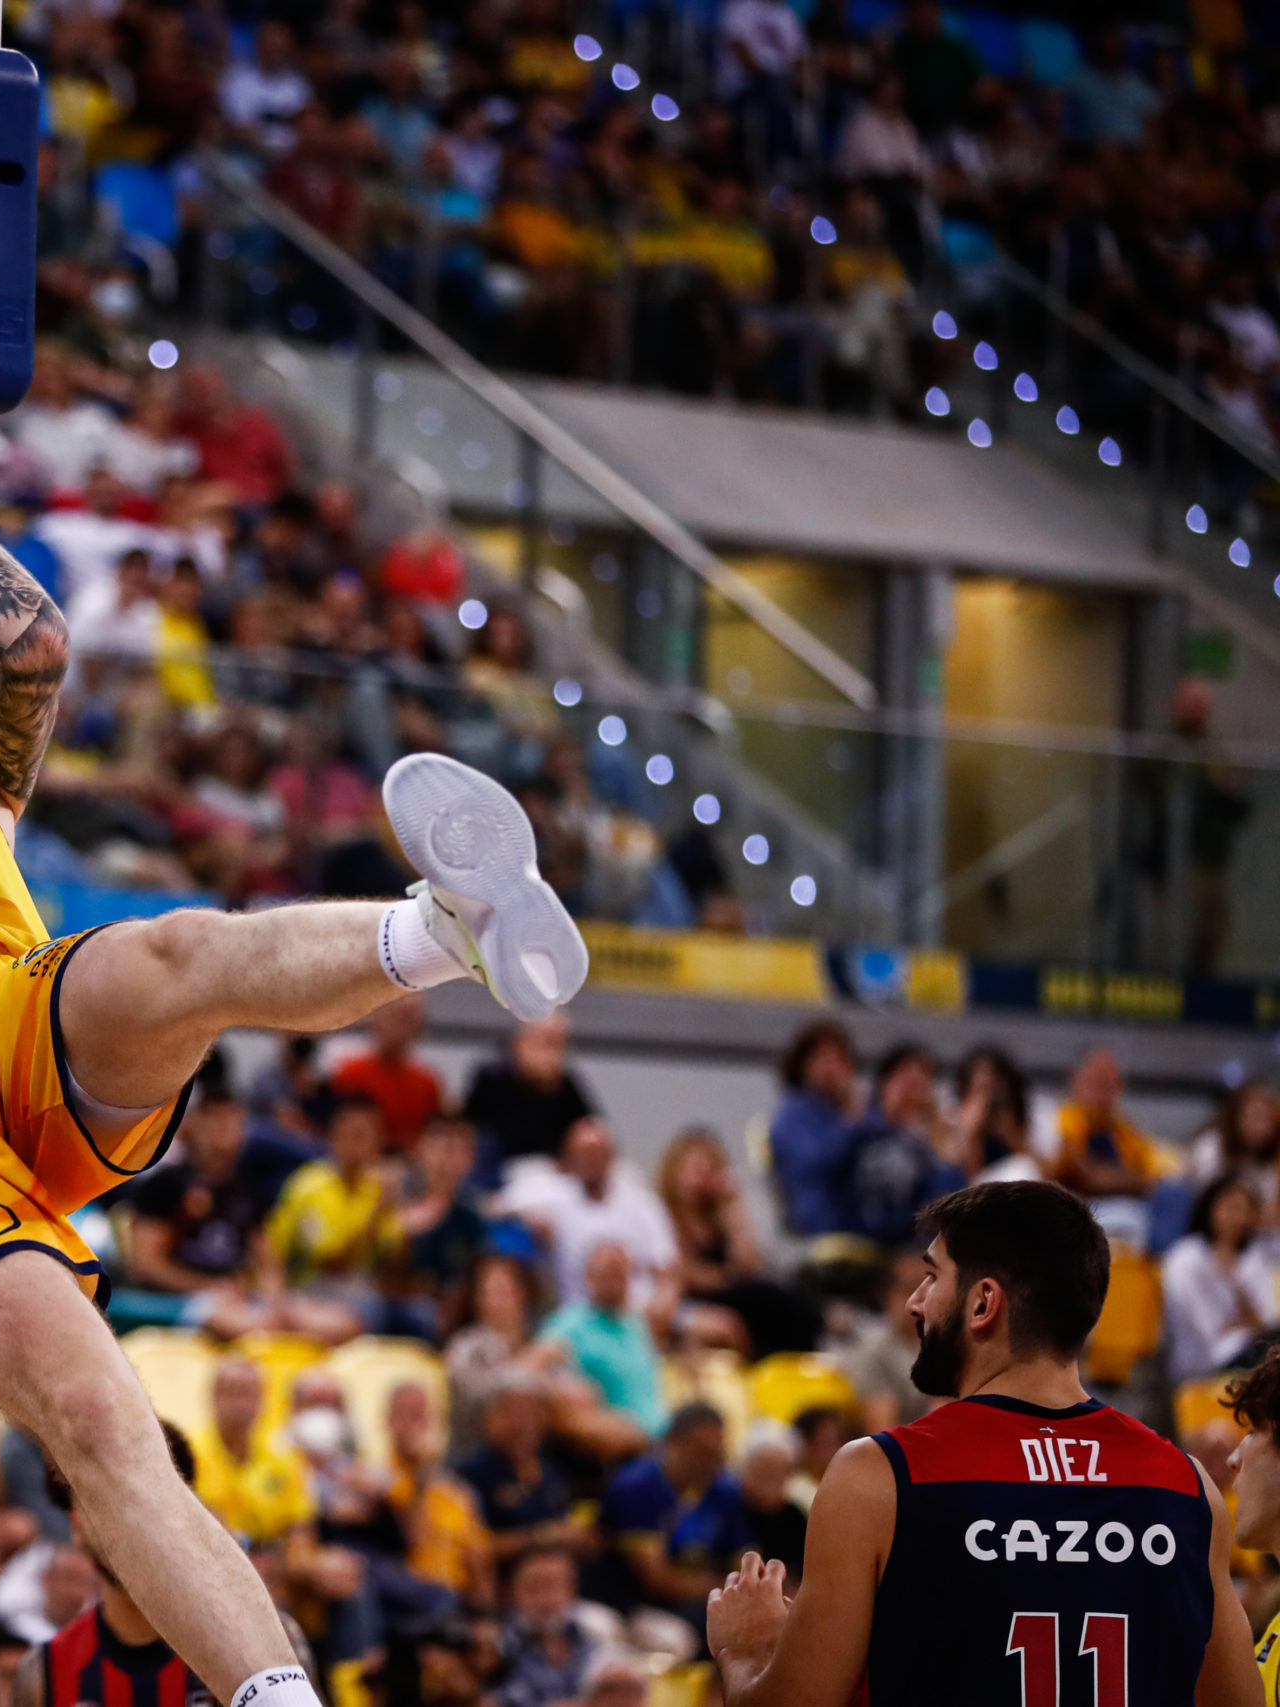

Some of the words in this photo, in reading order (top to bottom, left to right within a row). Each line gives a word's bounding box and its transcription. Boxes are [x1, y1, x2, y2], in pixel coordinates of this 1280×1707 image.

[1020, 1438, 1108, 1482] DIEZ
[964, 1519, 1177, 1566] CAZOO
[1005, 1611, 1129, 1707] 11
